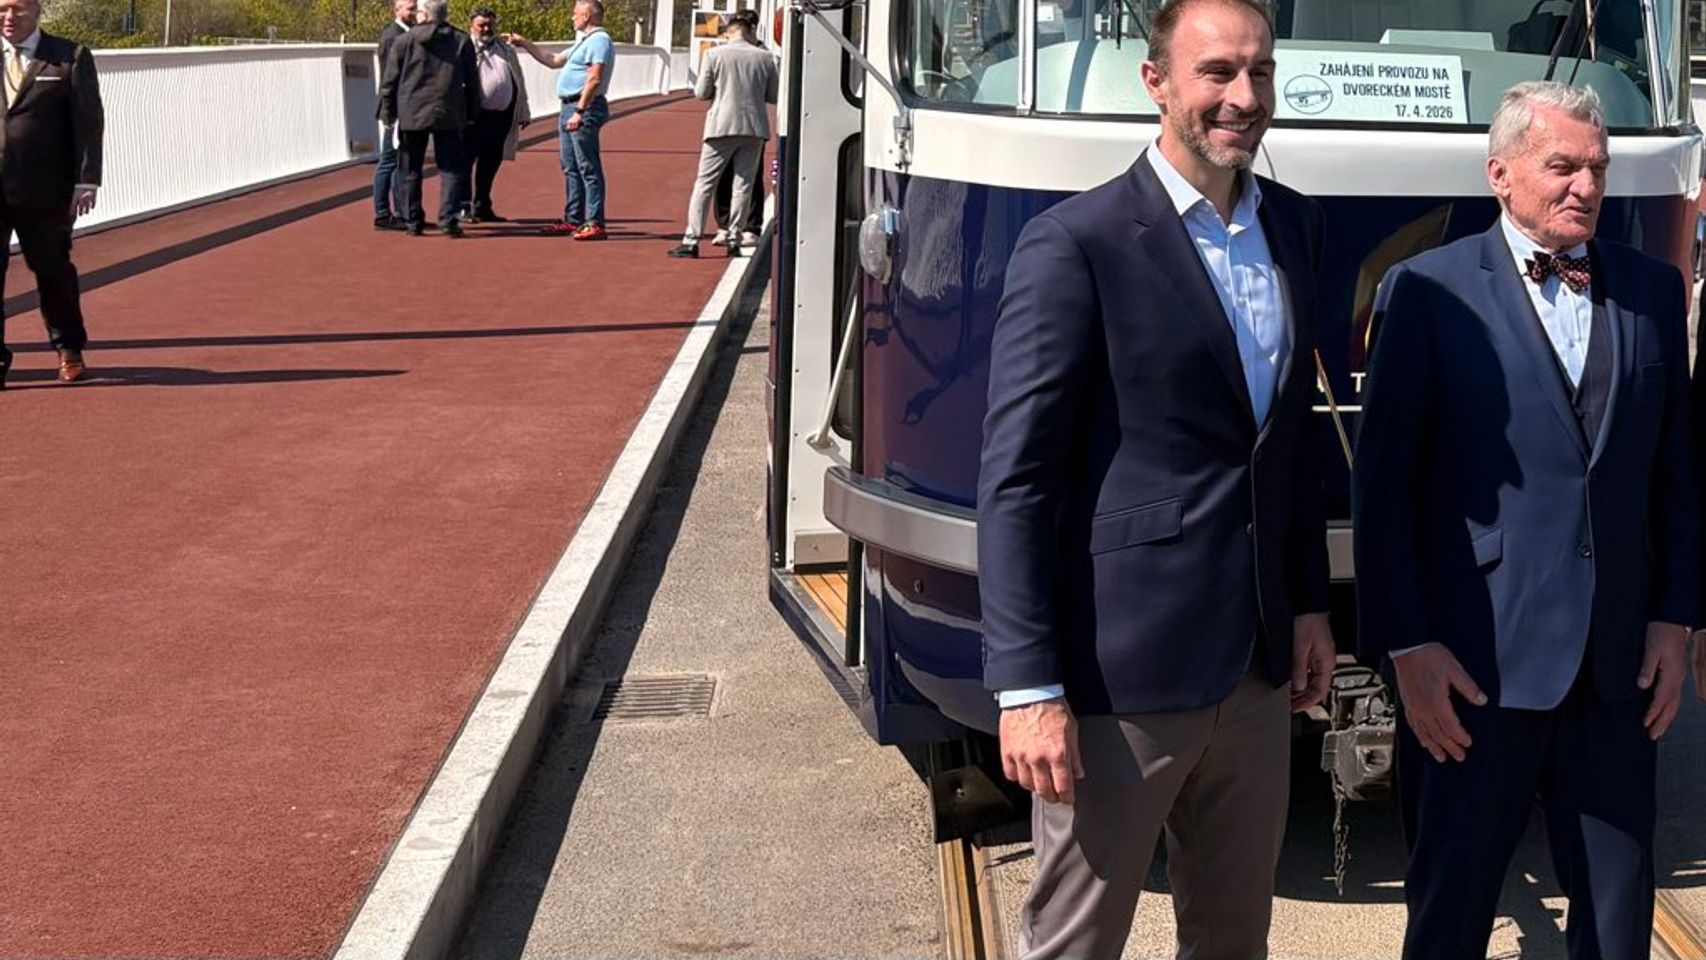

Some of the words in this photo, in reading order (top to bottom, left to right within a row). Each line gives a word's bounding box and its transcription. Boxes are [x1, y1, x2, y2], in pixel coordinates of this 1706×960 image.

[1319, 62, 1375, 78] ZAHÁJENÍ
[1378, 65, 1429, 80] PROVOZU
[1432, 67, 1450, 80] NA
[1343, 82, 1411, 98] DVORECKÉM
